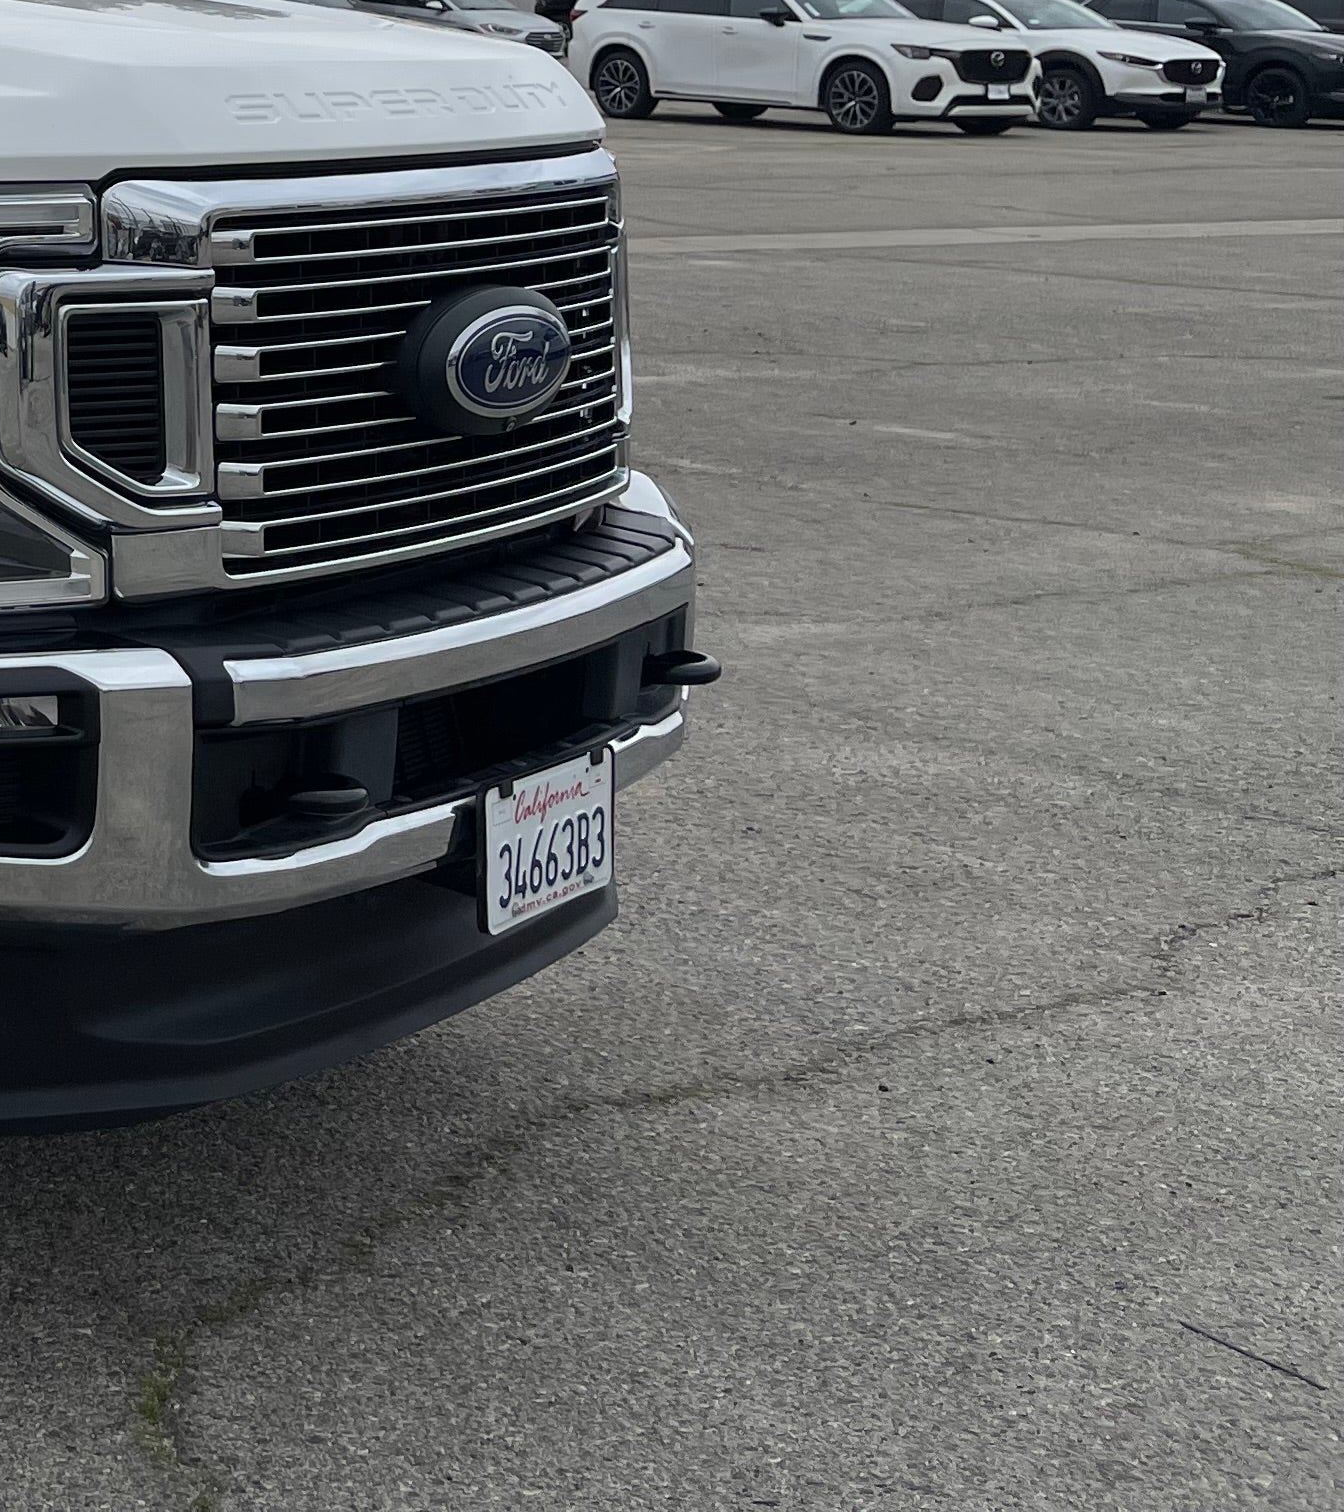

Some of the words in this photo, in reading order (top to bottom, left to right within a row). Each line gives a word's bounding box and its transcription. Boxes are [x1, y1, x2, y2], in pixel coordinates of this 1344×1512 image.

[224, 89, 454, 126] SUPER
[453, 81, 569, 116] DUTY
[484, 330, 550, 394] Ford
[514, 781, 590, 824] California
[498, 806, 606, 909] 34663B3
[520, 880, 582, 913] dmv.ca.gov
